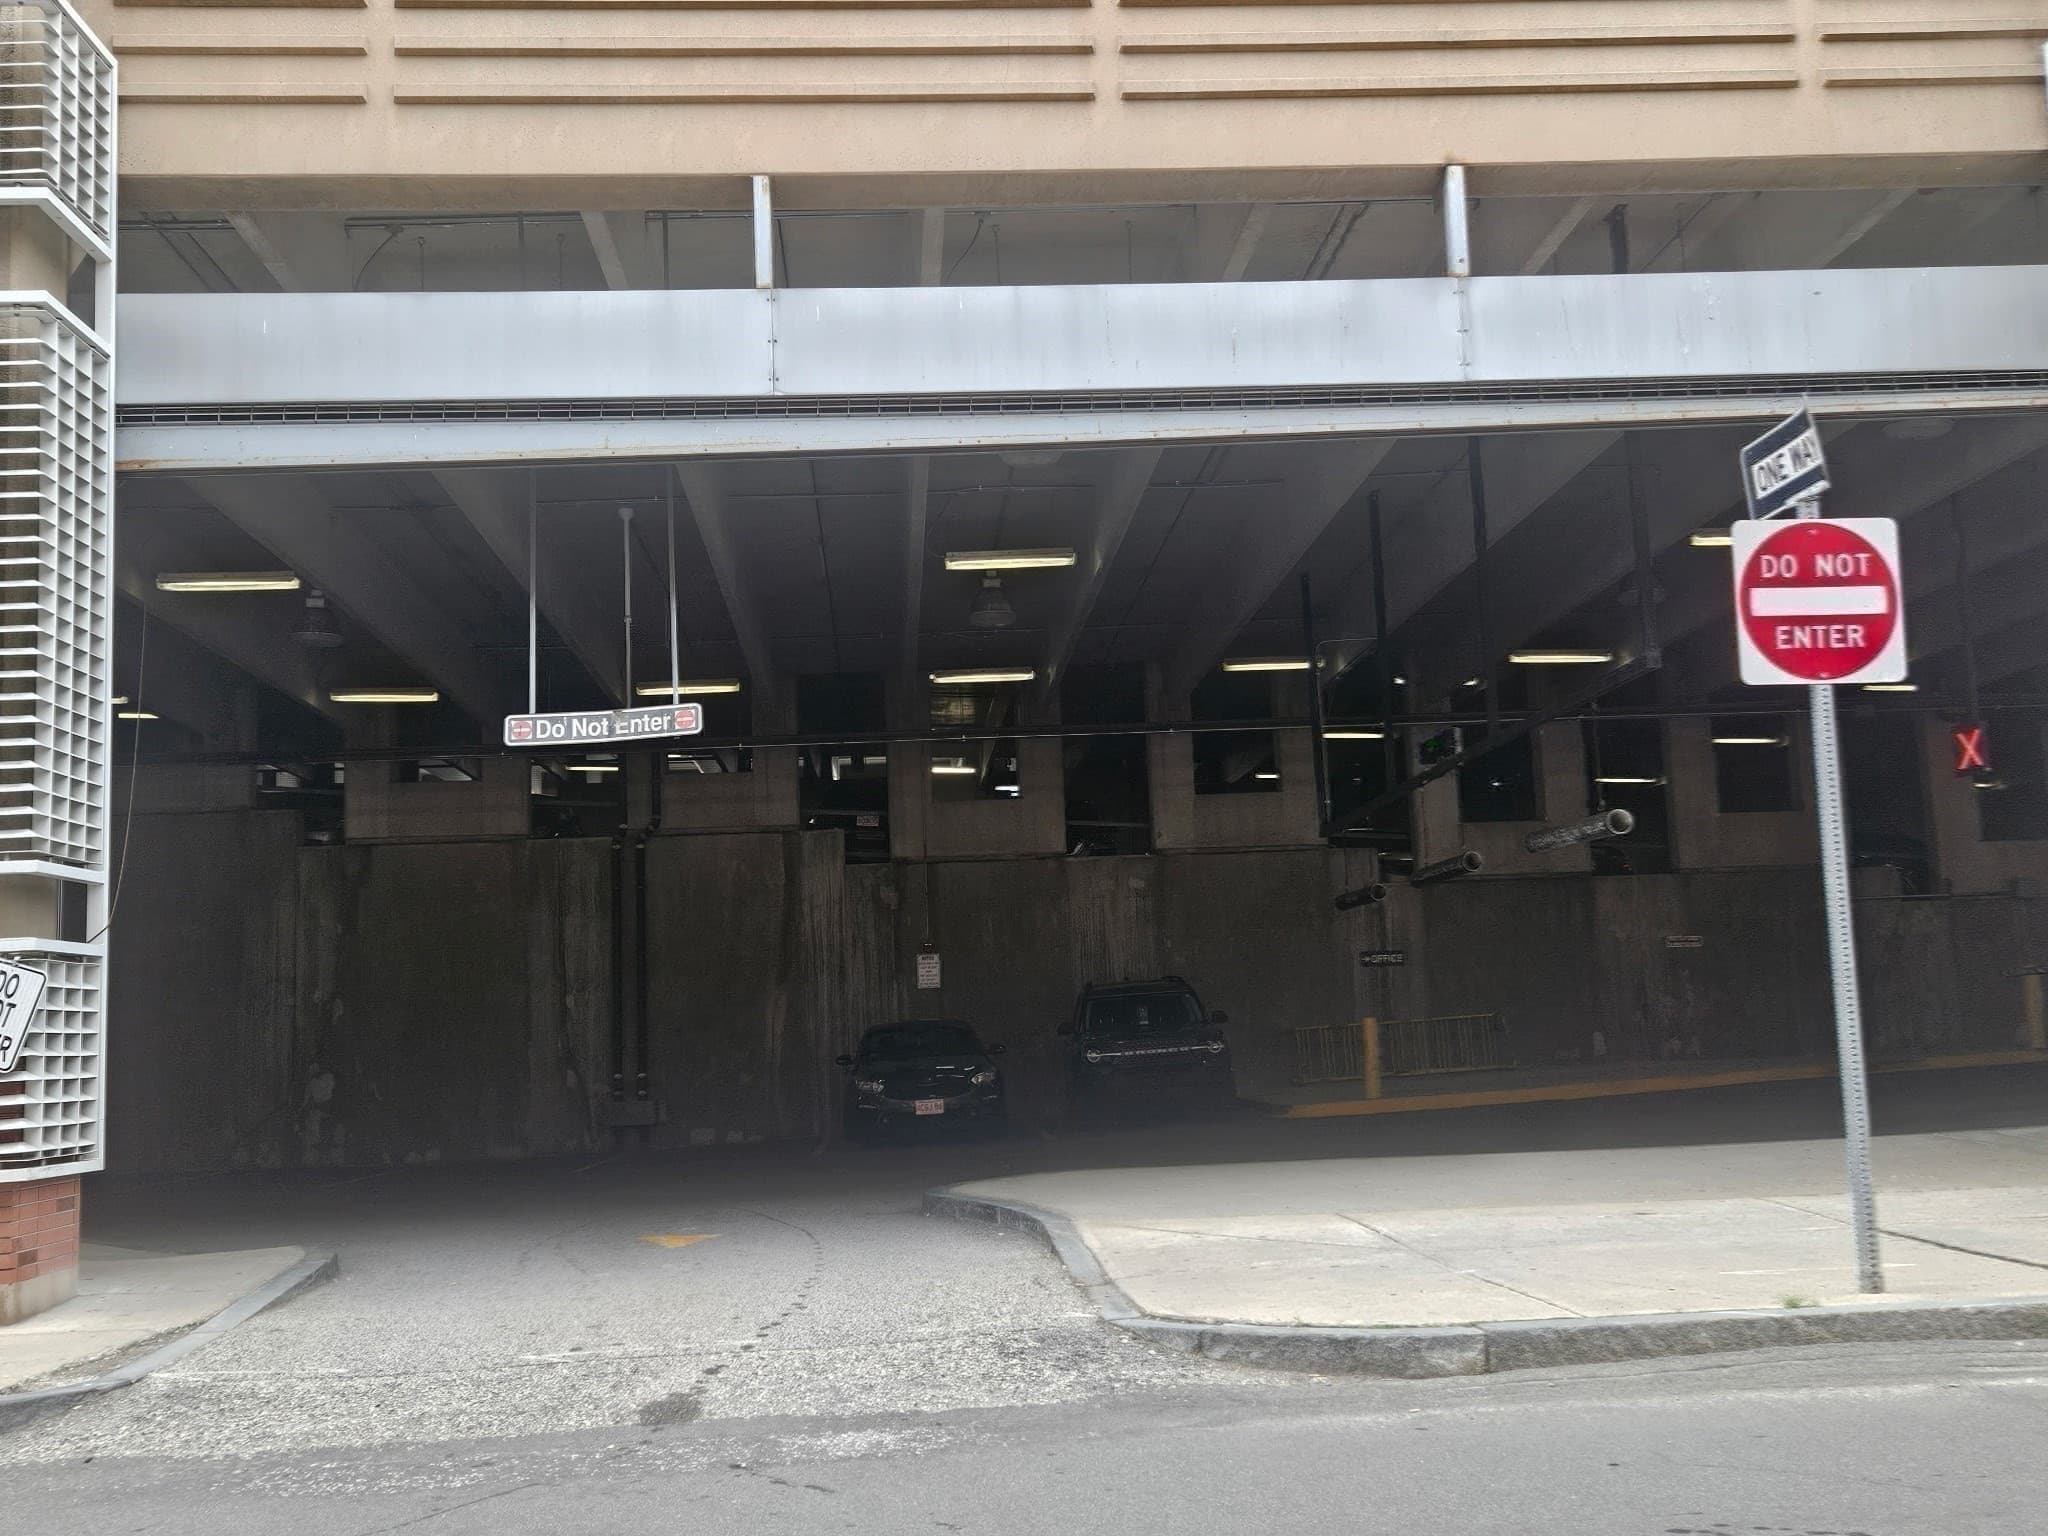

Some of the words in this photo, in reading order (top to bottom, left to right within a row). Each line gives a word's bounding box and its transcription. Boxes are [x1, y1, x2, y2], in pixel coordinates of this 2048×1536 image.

[1756, 451, 1788, 491] ONE
[1789, 435, 1816, 472] WAY
[1760, 554, 1798, 578] DO
[1814, 553, 1870, 577] NOT
[1775, 624, 1865, 650] ENTER
[536, 719, 565, 738] Do
[572, 717, 609, 738] Not
[615, 713, 671, 735] Enter
[1370, 953, 1404, 963] OFFICE
